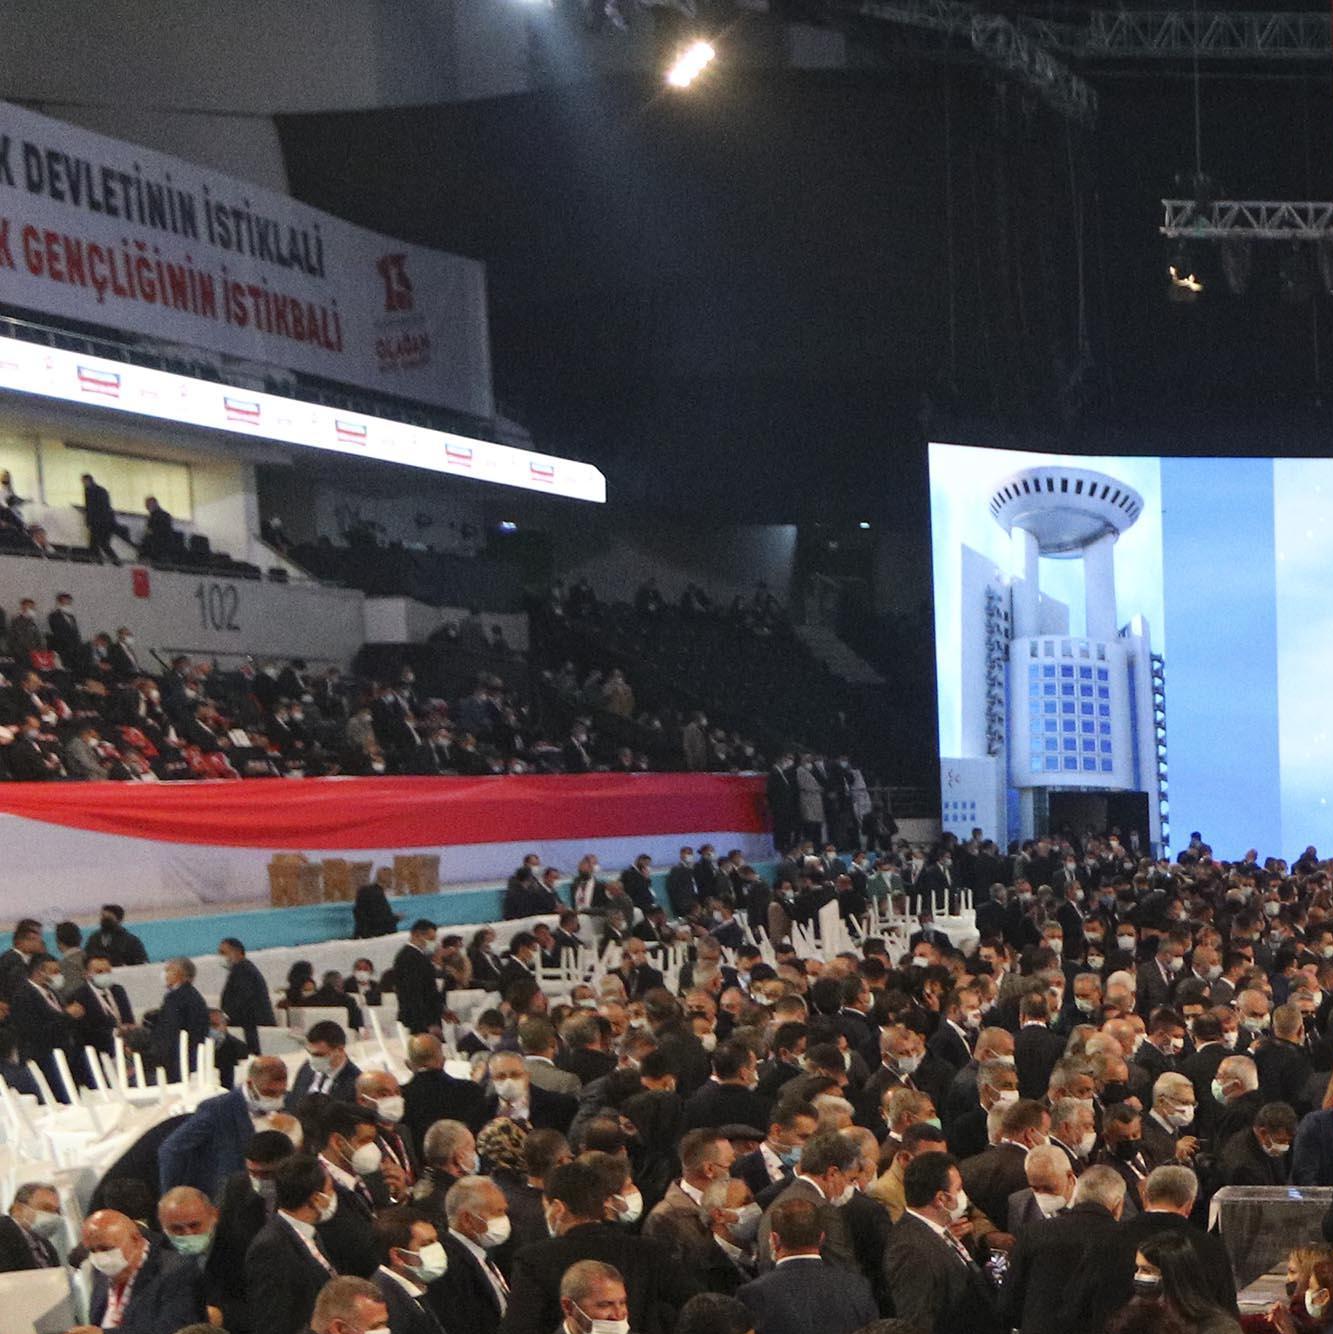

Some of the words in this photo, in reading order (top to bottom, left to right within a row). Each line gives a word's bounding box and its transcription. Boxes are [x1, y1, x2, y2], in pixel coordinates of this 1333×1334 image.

[22, 141, 198, 240] DEVLETİNİN
[203, 183, 325, 278] İSTİKLALİ
[22, 224, 218, 321] GENÇLİĞİNİN
[221, 264, 342, 352] İSTİKBALİ
[194, 583, 240, 631] 102
